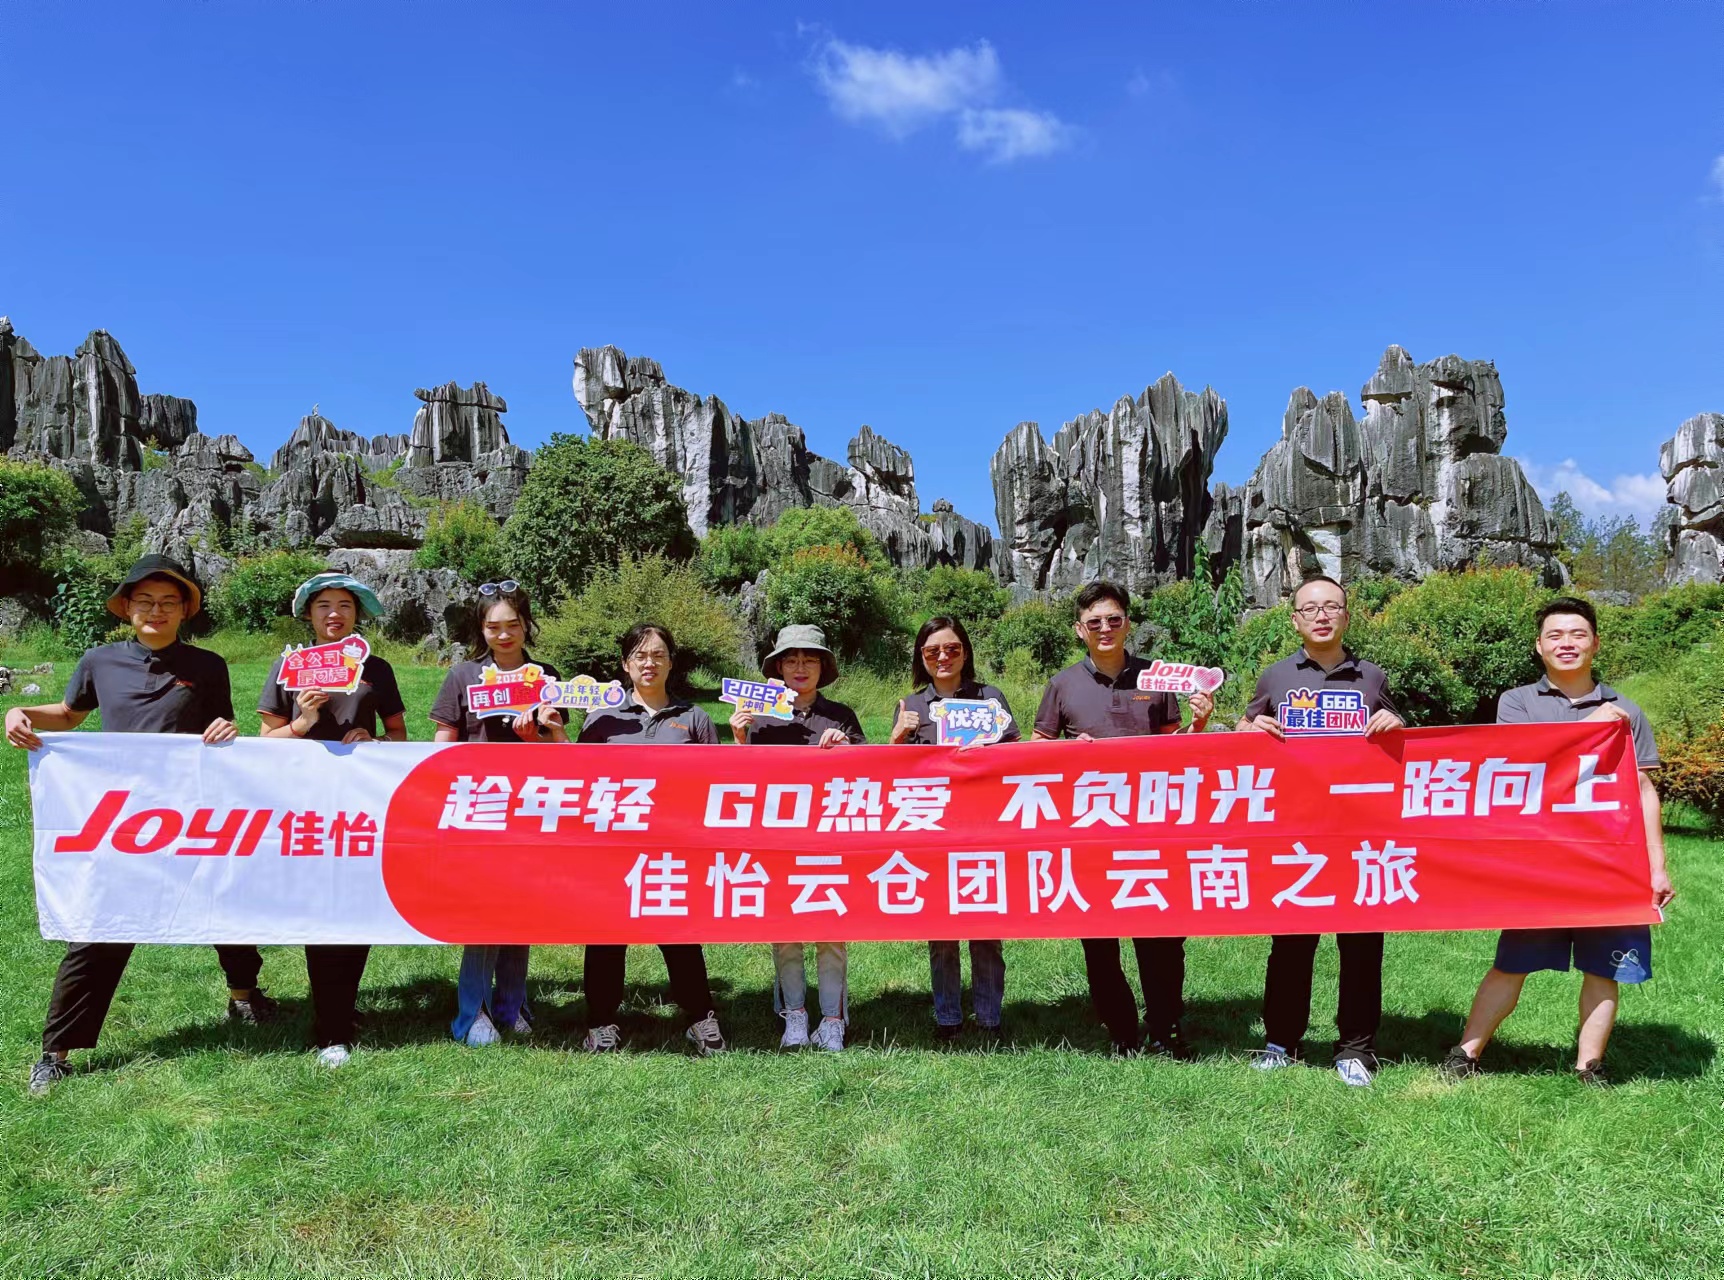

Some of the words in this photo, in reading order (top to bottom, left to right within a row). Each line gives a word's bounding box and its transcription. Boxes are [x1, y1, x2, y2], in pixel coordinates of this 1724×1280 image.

[287, 650, 340, 670] 全公司
[297, 666, 349, 686] 最可爱
[496, 673, 524, 684] 2022
[1140, 677, 1192, 692] 佳怡云仓
[564, 684, 600, 695] 趁年轻
[728, 680, 777, 702] 2022
[1322, 694, 1358, 710] 666
[947, 707, 993, 732] 优秀
[1286, 708, 1361, 729] 最佳团队
[438, 775, 657, 833] 趁年轻
[704, 777, 952, 833] GO热爱
[999, 766, 1276, 829] 不负时光
[1329, 754, 1623, 819] 一路向上
[277, 811, 378, 857] 佳怡
[624, 840, 1420, 918] 佳怡云仓团队云南之旅
